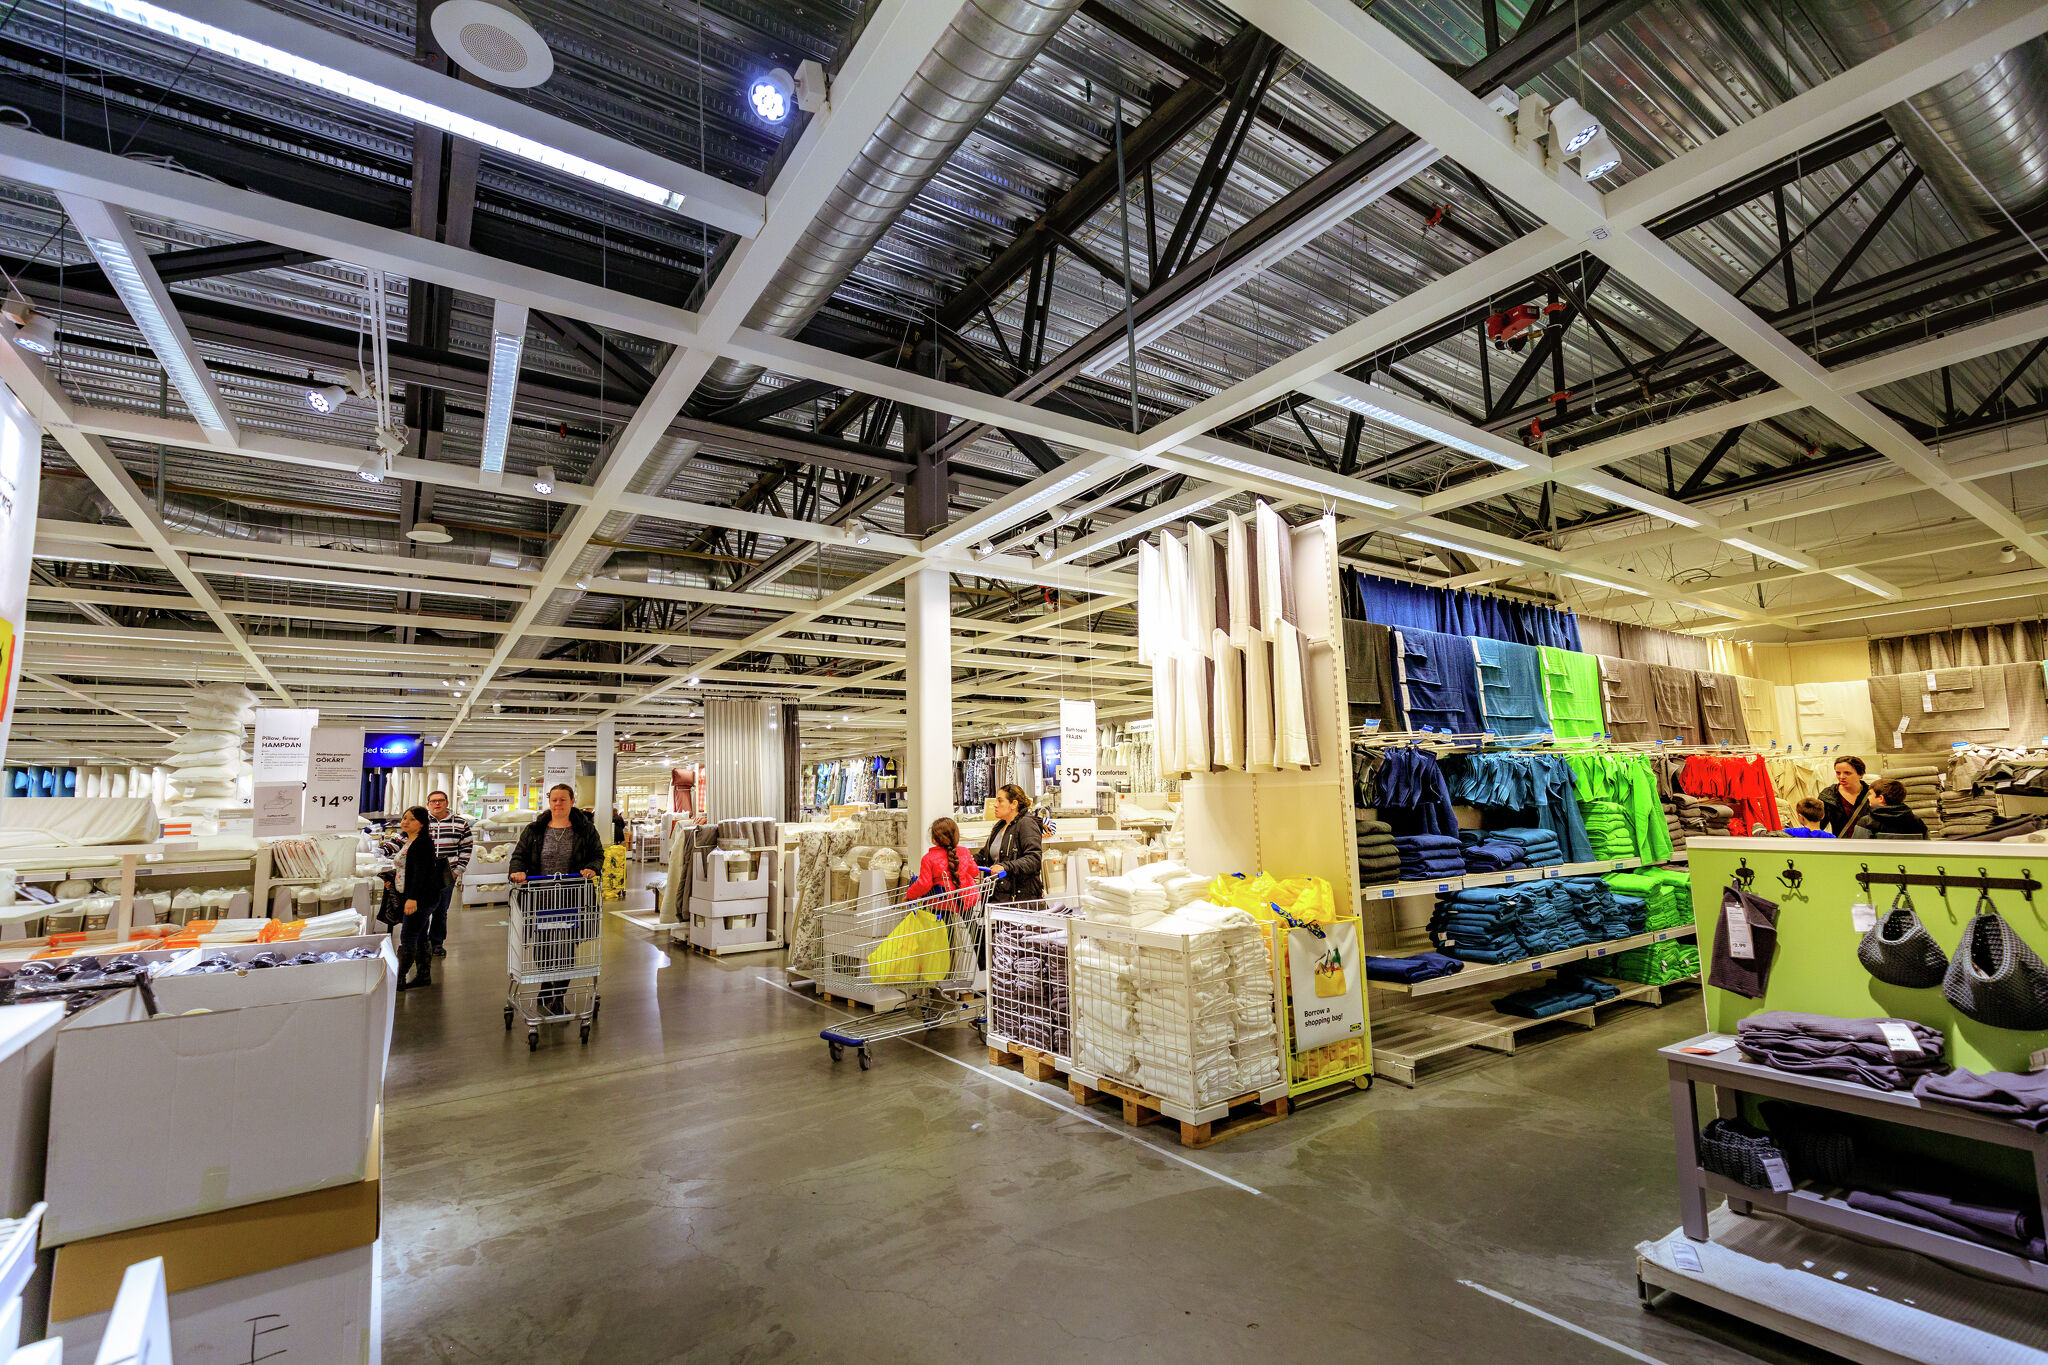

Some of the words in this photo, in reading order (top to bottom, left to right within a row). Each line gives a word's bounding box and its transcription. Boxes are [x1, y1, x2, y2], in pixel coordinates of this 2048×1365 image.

[622, 743, 634, 751] EXIT
[1304, 1009, 1324, 1017] Borrow
[1304, 1016, 1331, 1027] shopping
[1332, 1013, 1344, 1022] bag!
